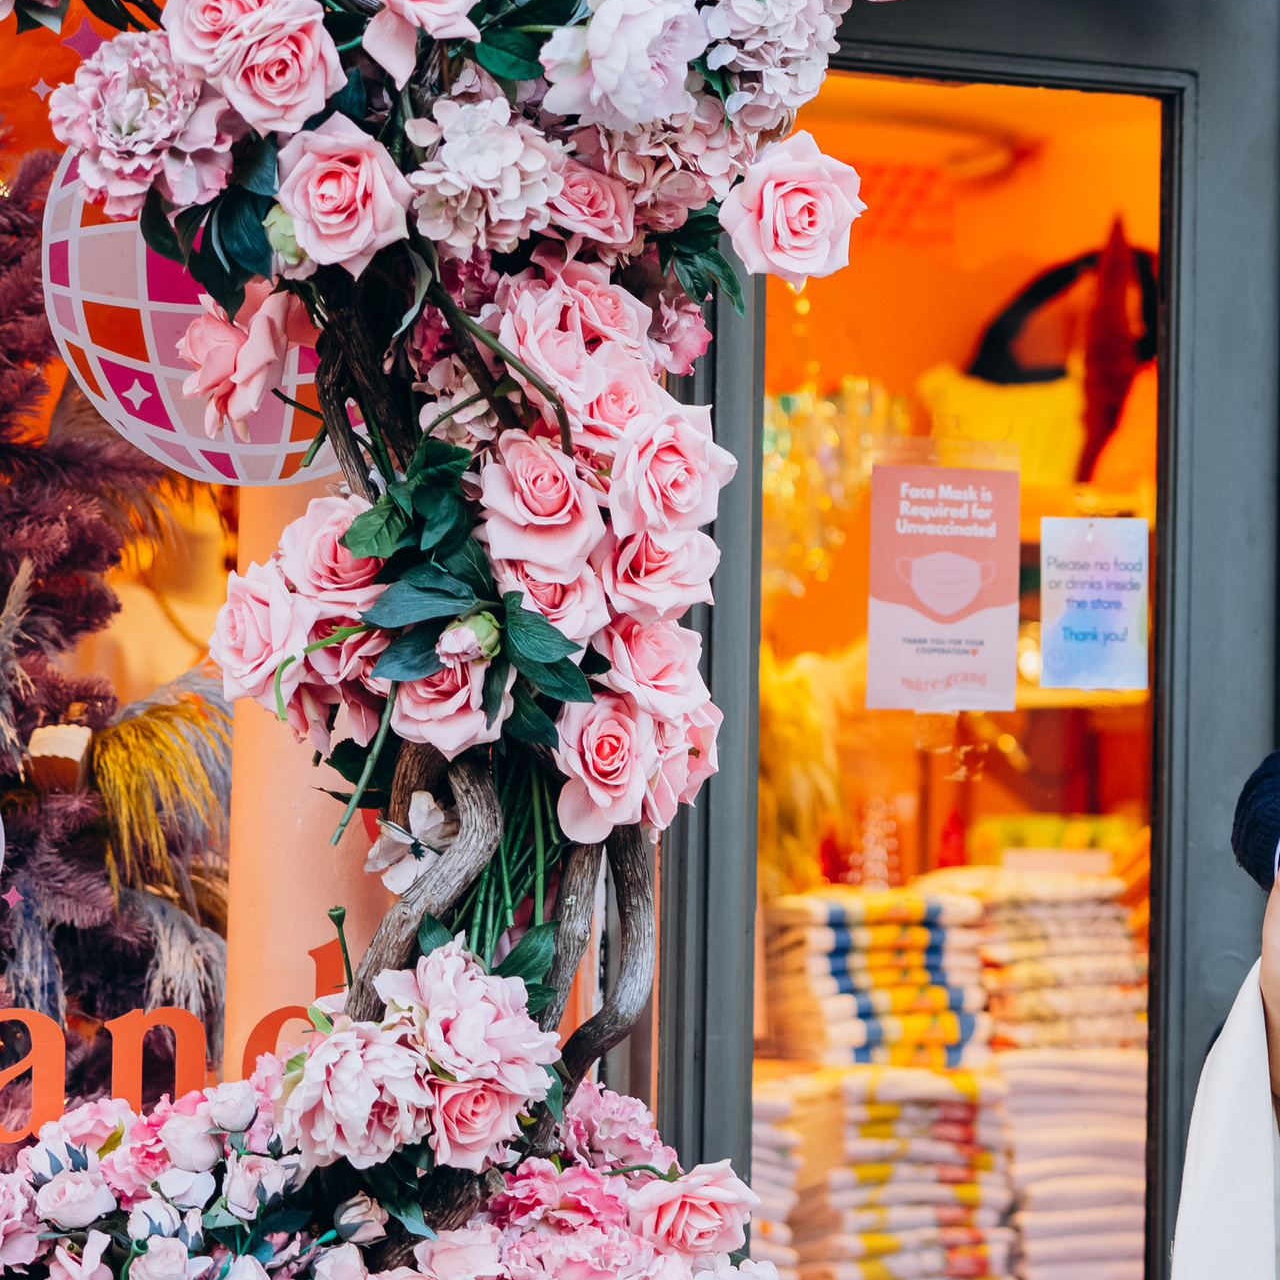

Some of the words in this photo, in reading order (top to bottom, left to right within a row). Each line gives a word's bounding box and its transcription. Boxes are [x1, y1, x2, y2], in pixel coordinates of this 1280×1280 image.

[900, 482, 936, 499] Face
[938, 484, 978, 501] Mask
[980, 485, 993, 502] is
[900, 500, 969, 521] Required
[971, 502, 994, 519] for
[895, 517, 997, 538] Unvaccinated
[1046, 555, 1091, 571] Please
[1093, 560, 1110, 571] no
[1113, 556, 1143, 572] food
[1048, 579, 1062, 590] or
[1065, 575, 1102, 591] drinks
[1106, 576, 1141, 591] inside
[1066, 595, 1088, 610] the
[902, 637, 928, 645] THANK
[965, 639, 984, 647] YOUR
[1061, 626, 1098, 642] Thank
[1101, 627, 1129, 646] you!
[916, 647, 970, 655] COOPERATION
